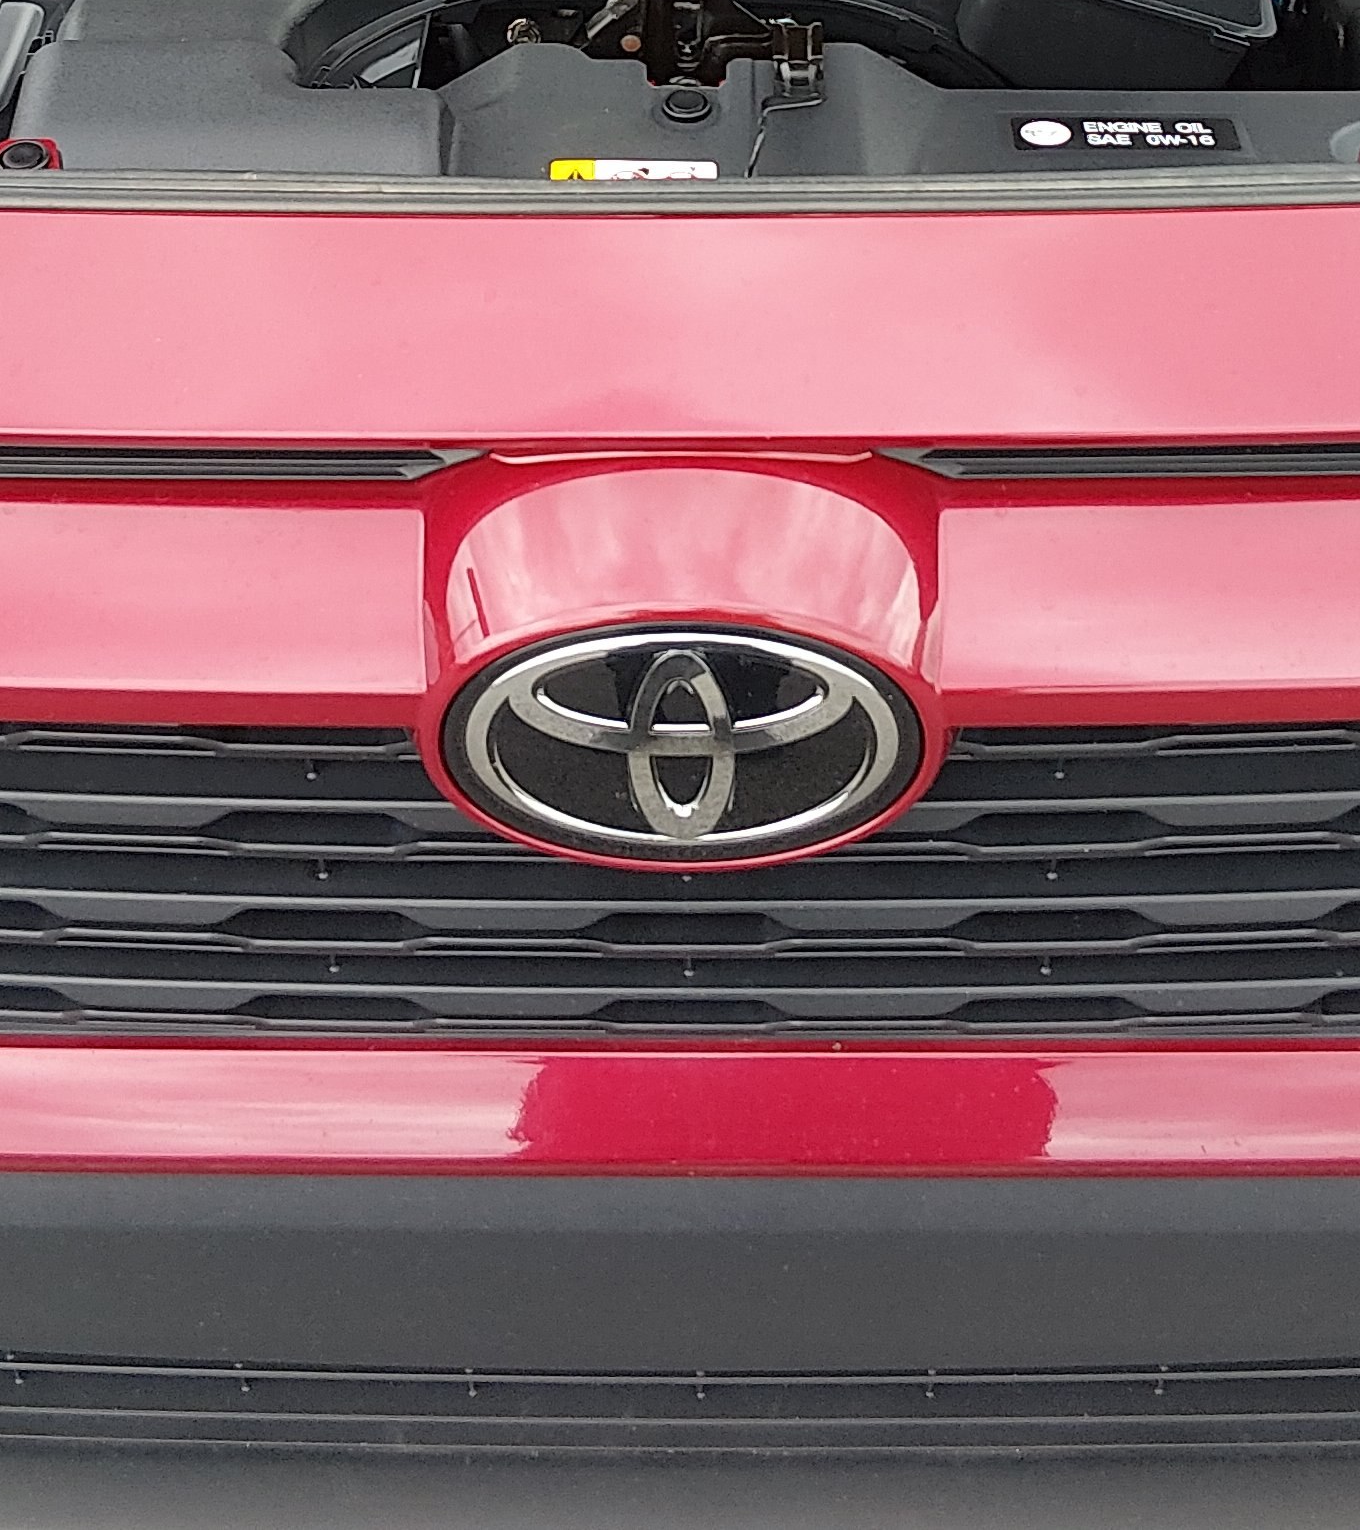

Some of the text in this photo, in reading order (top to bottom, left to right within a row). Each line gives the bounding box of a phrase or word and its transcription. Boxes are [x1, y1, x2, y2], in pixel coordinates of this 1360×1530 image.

[1083, 121, 1213, 134] ENGINE OIL
[1086, 134, 1216, 146] SAE 0W-16
